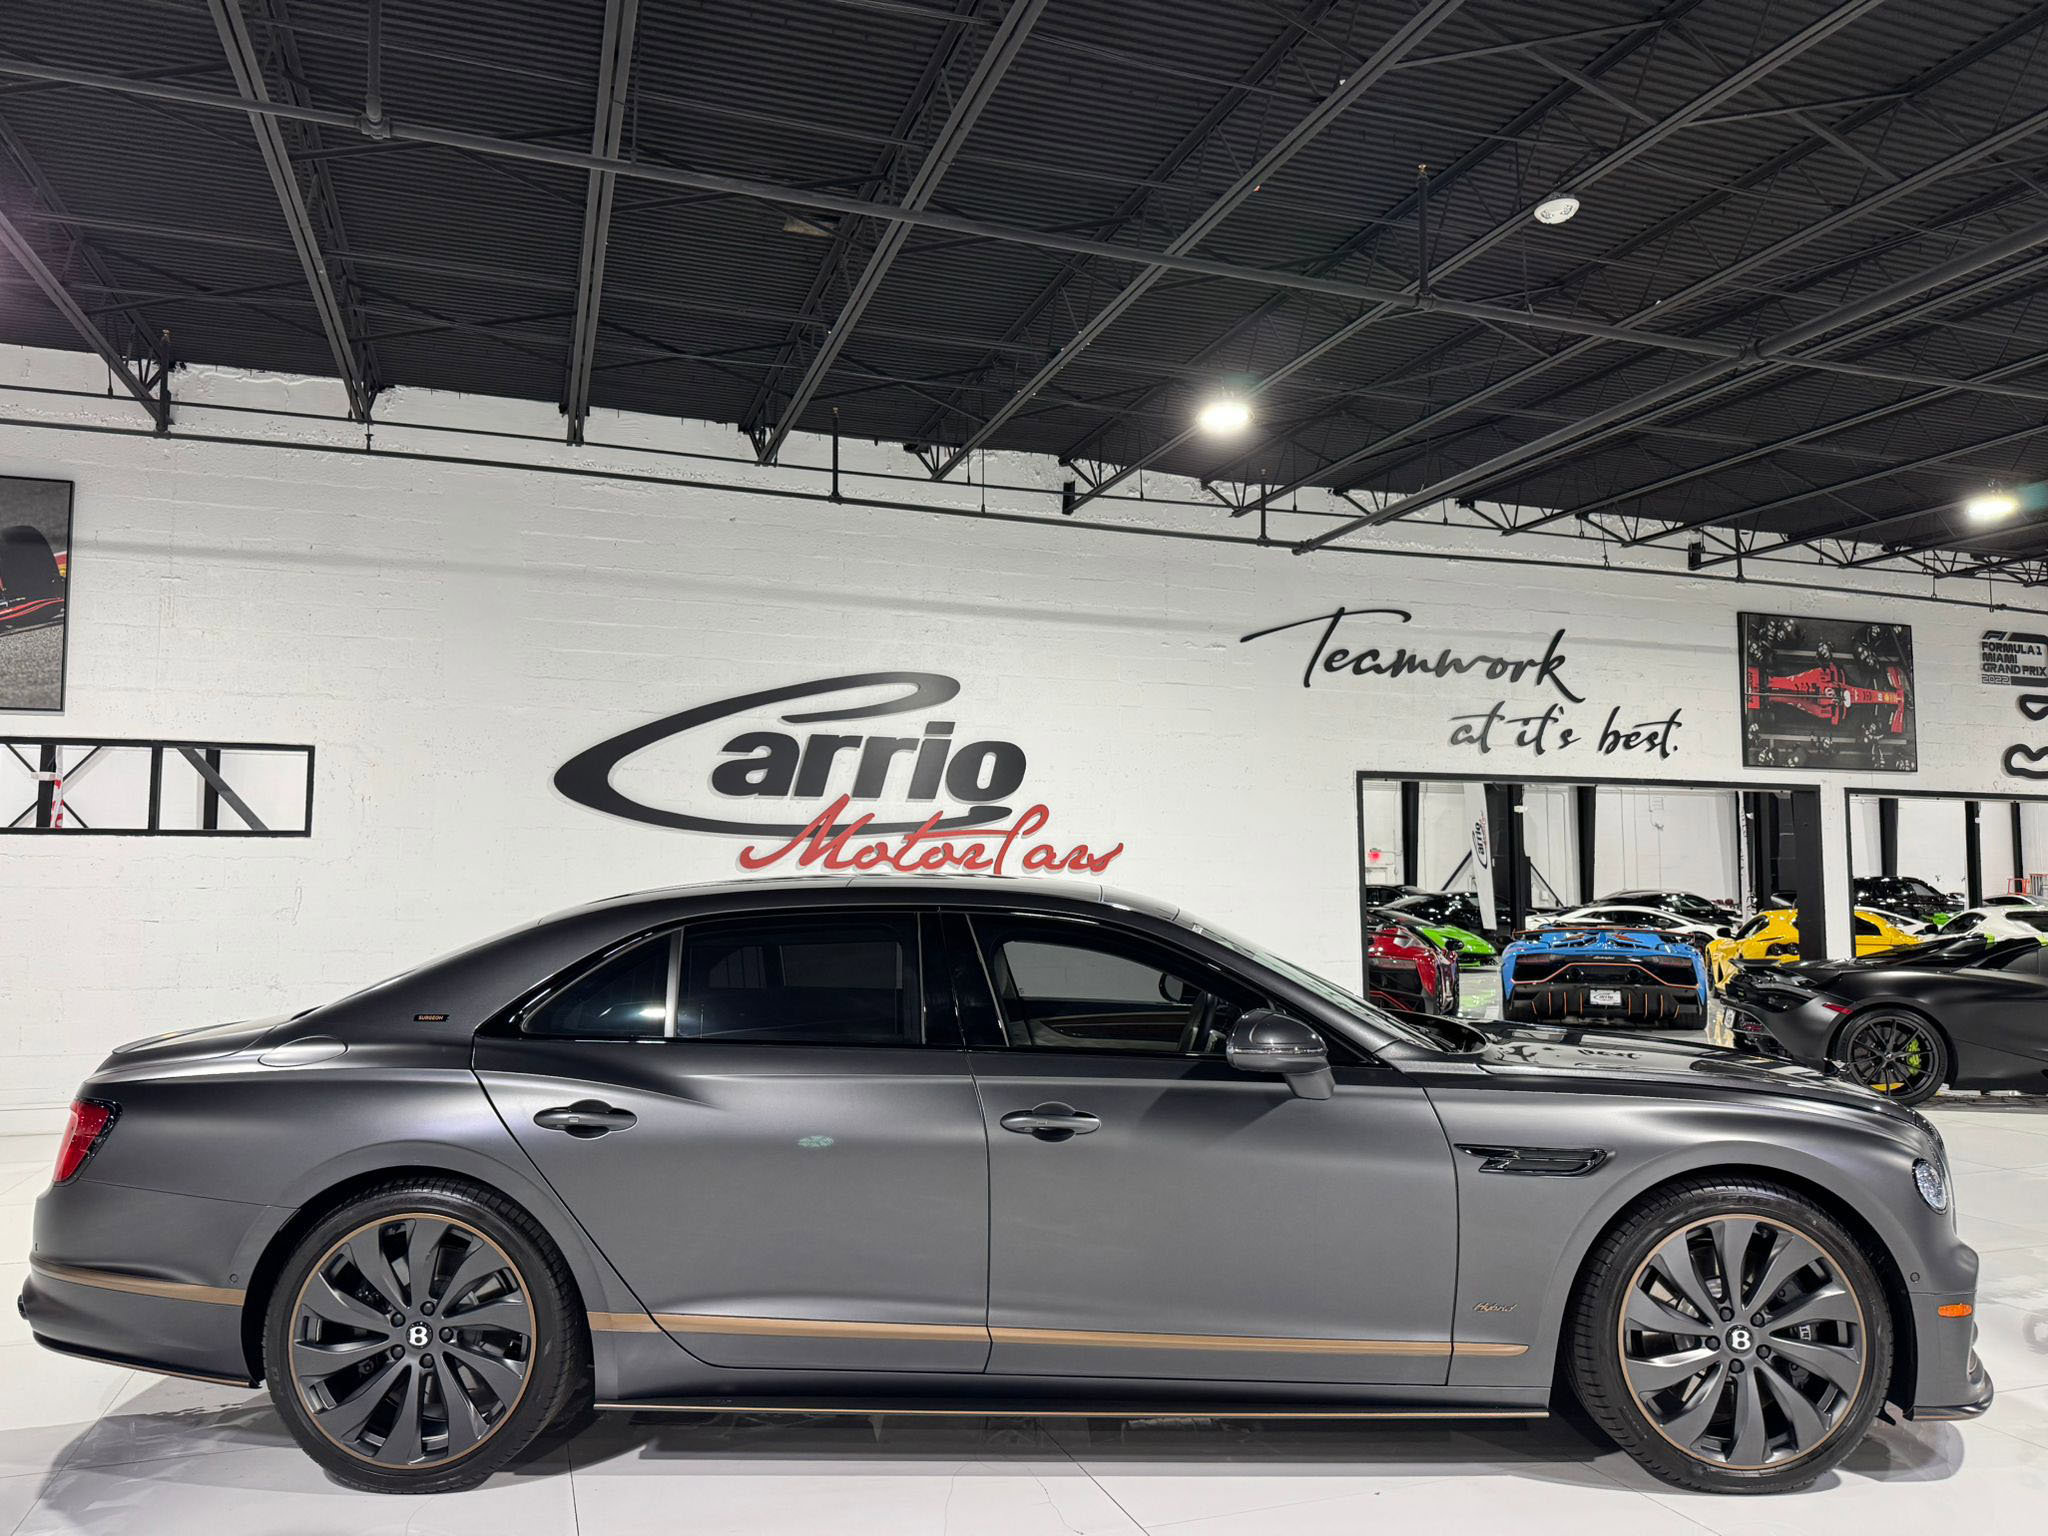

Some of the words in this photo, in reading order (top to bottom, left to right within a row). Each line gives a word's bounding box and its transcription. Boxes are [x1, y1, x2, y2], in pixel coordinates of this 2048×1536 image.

[1240, 607, 1586, 703] Teamwork
[1981, 641, 2035, 655] FORMULA
[2036, 645, 2043, 656] 1
[1982, 652, 2018, 664] MIAMI
[1982, 663, 2021, 674] GRAND
[2022, 665, 2047, 677] PRIX
[1981, 674, 2011, 685] 2022
[1450, 701, 1506, 754] at
[1507, 703, 1582, 755] it's
[1598, 706, 1683, 758] best.
[409, 1326, 428, 1346] B
[1732, 1330, 1751, 1350] B
